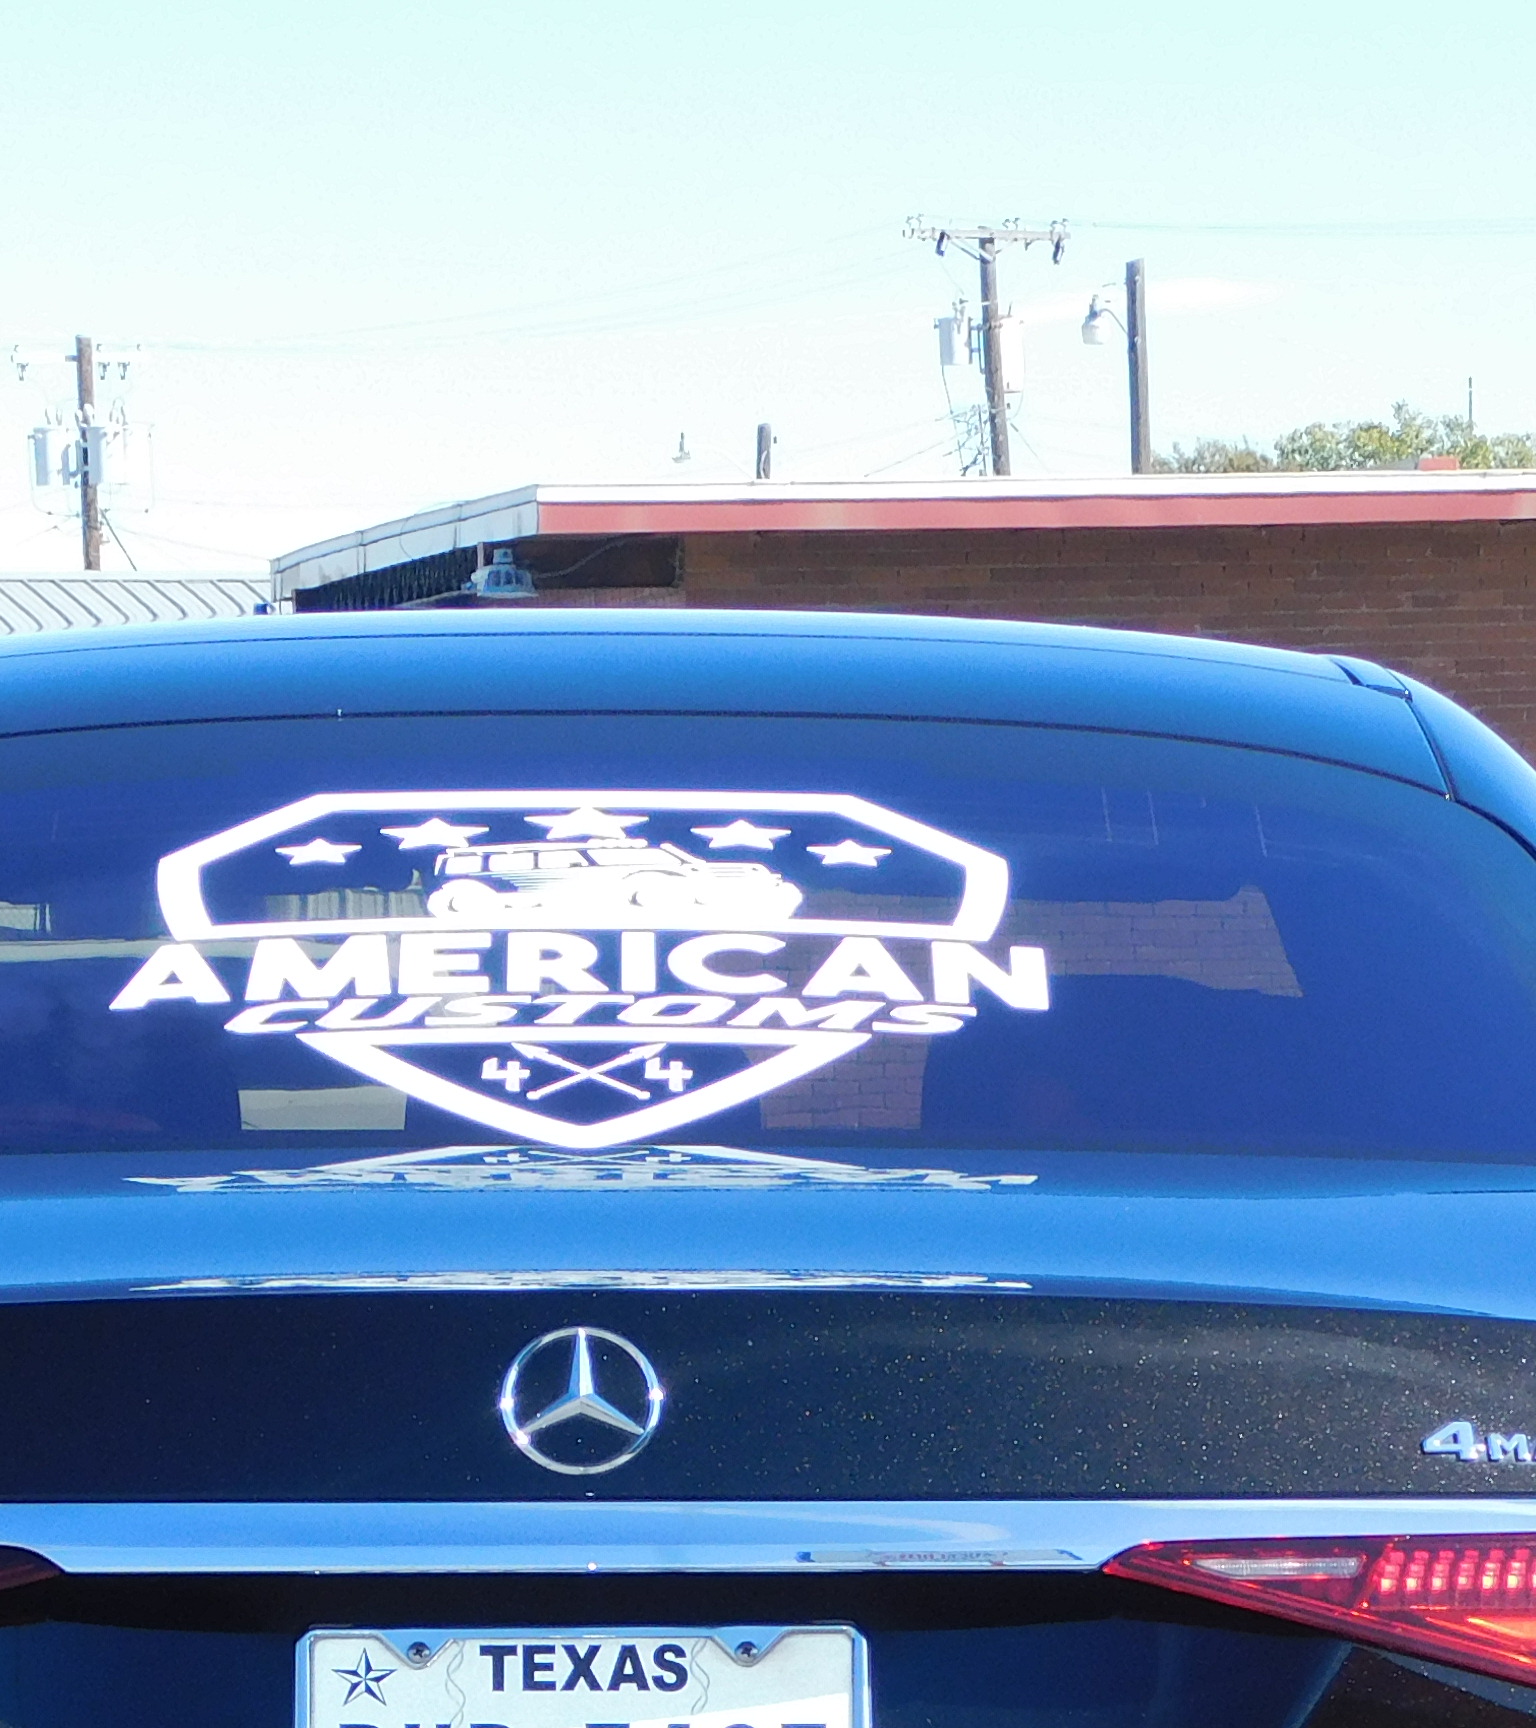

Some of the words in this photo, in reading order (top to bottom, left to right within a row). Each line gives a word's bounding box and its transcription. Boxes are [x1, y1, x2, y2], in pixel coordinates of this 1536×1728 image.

[109, 930, 1050, 1012] AMERICAN
[223, 992, 977, 1036] CUSTOMS
[479, 1643, 689, 1693] TEXAS
